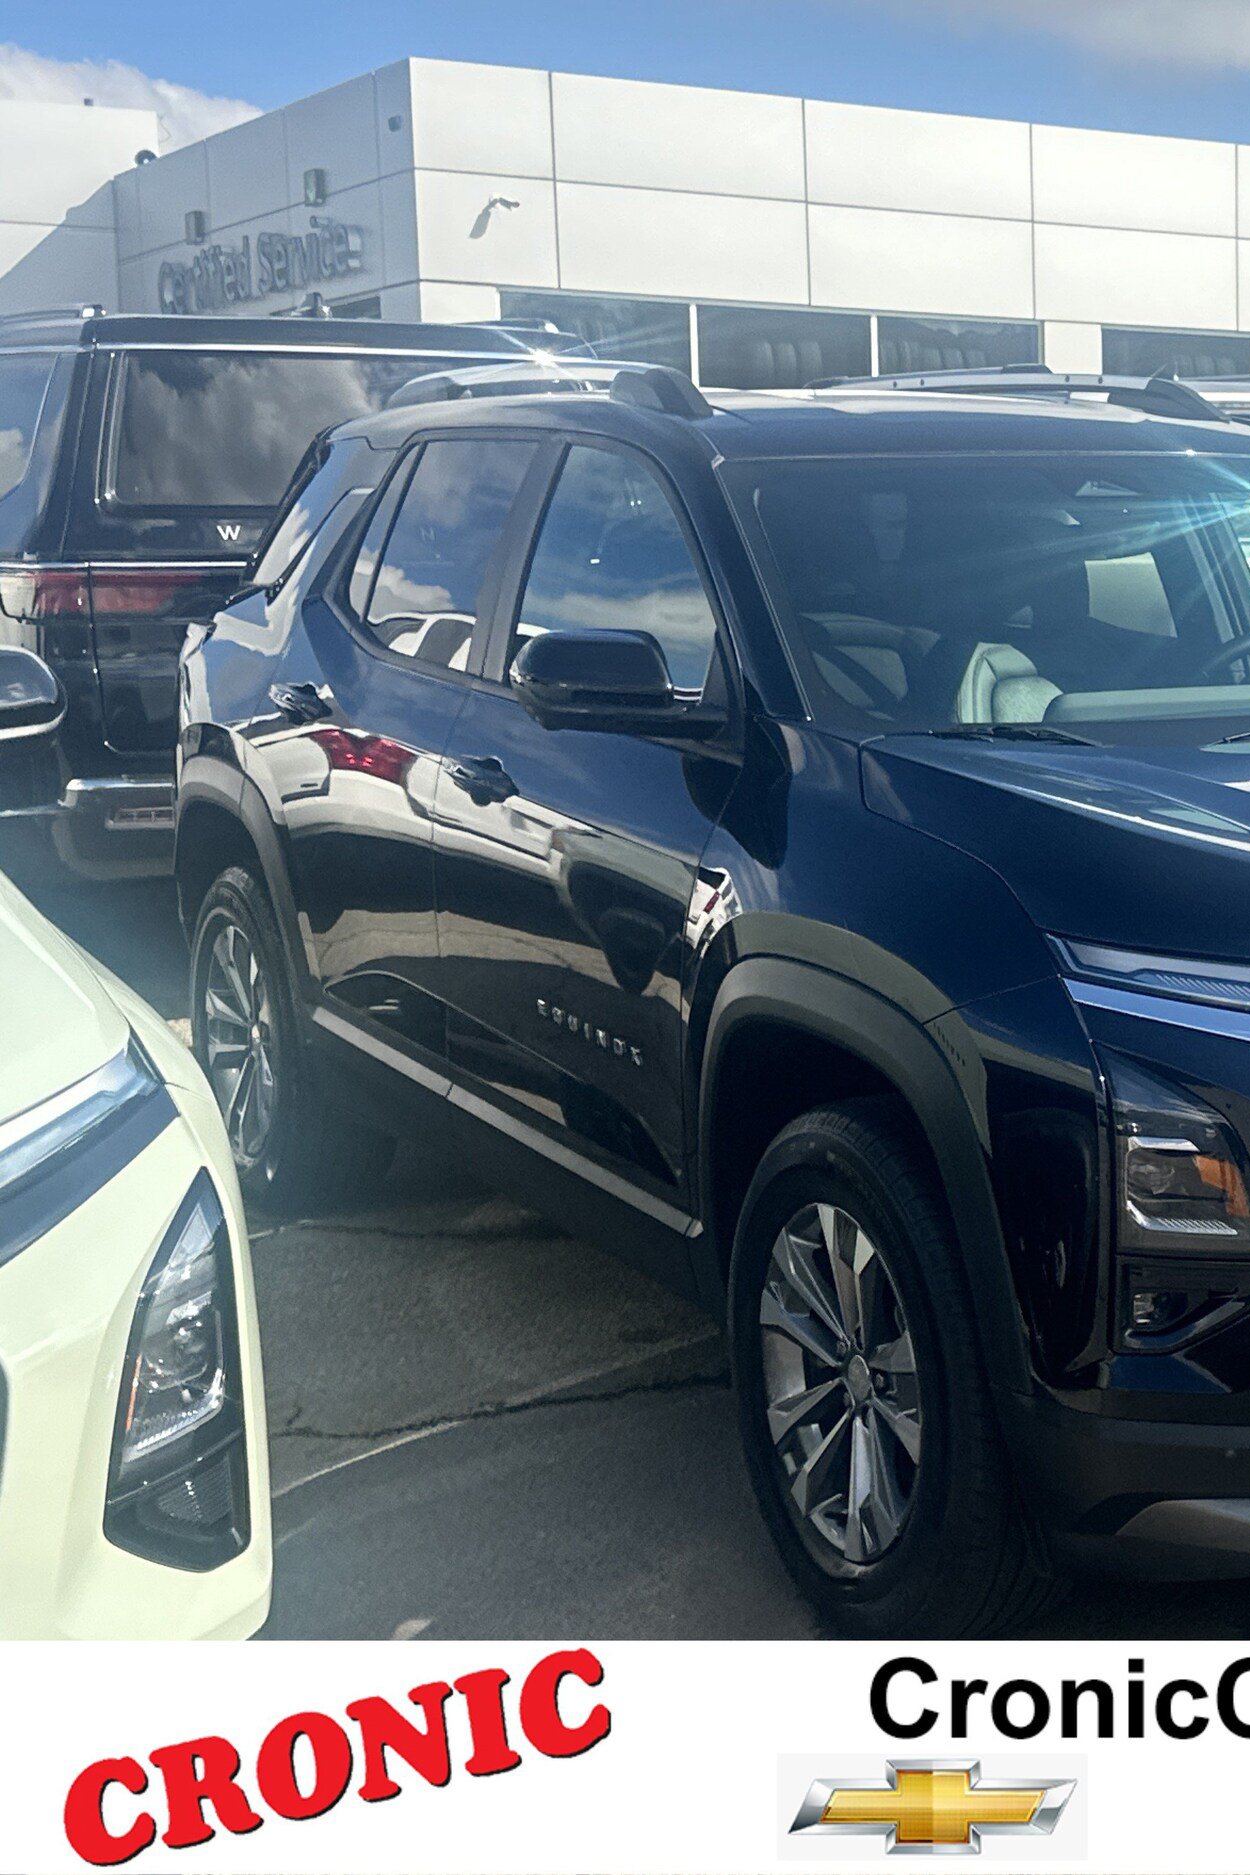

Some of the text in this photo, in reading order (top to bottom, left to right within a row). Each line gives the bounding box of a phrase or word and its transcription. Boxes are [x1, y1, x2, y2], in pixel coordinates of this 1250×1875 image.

[158, 235, 252, 314] Certified
[216, 524, 241, 541] W
[537, 998, 643, 1067] EQUINOX
